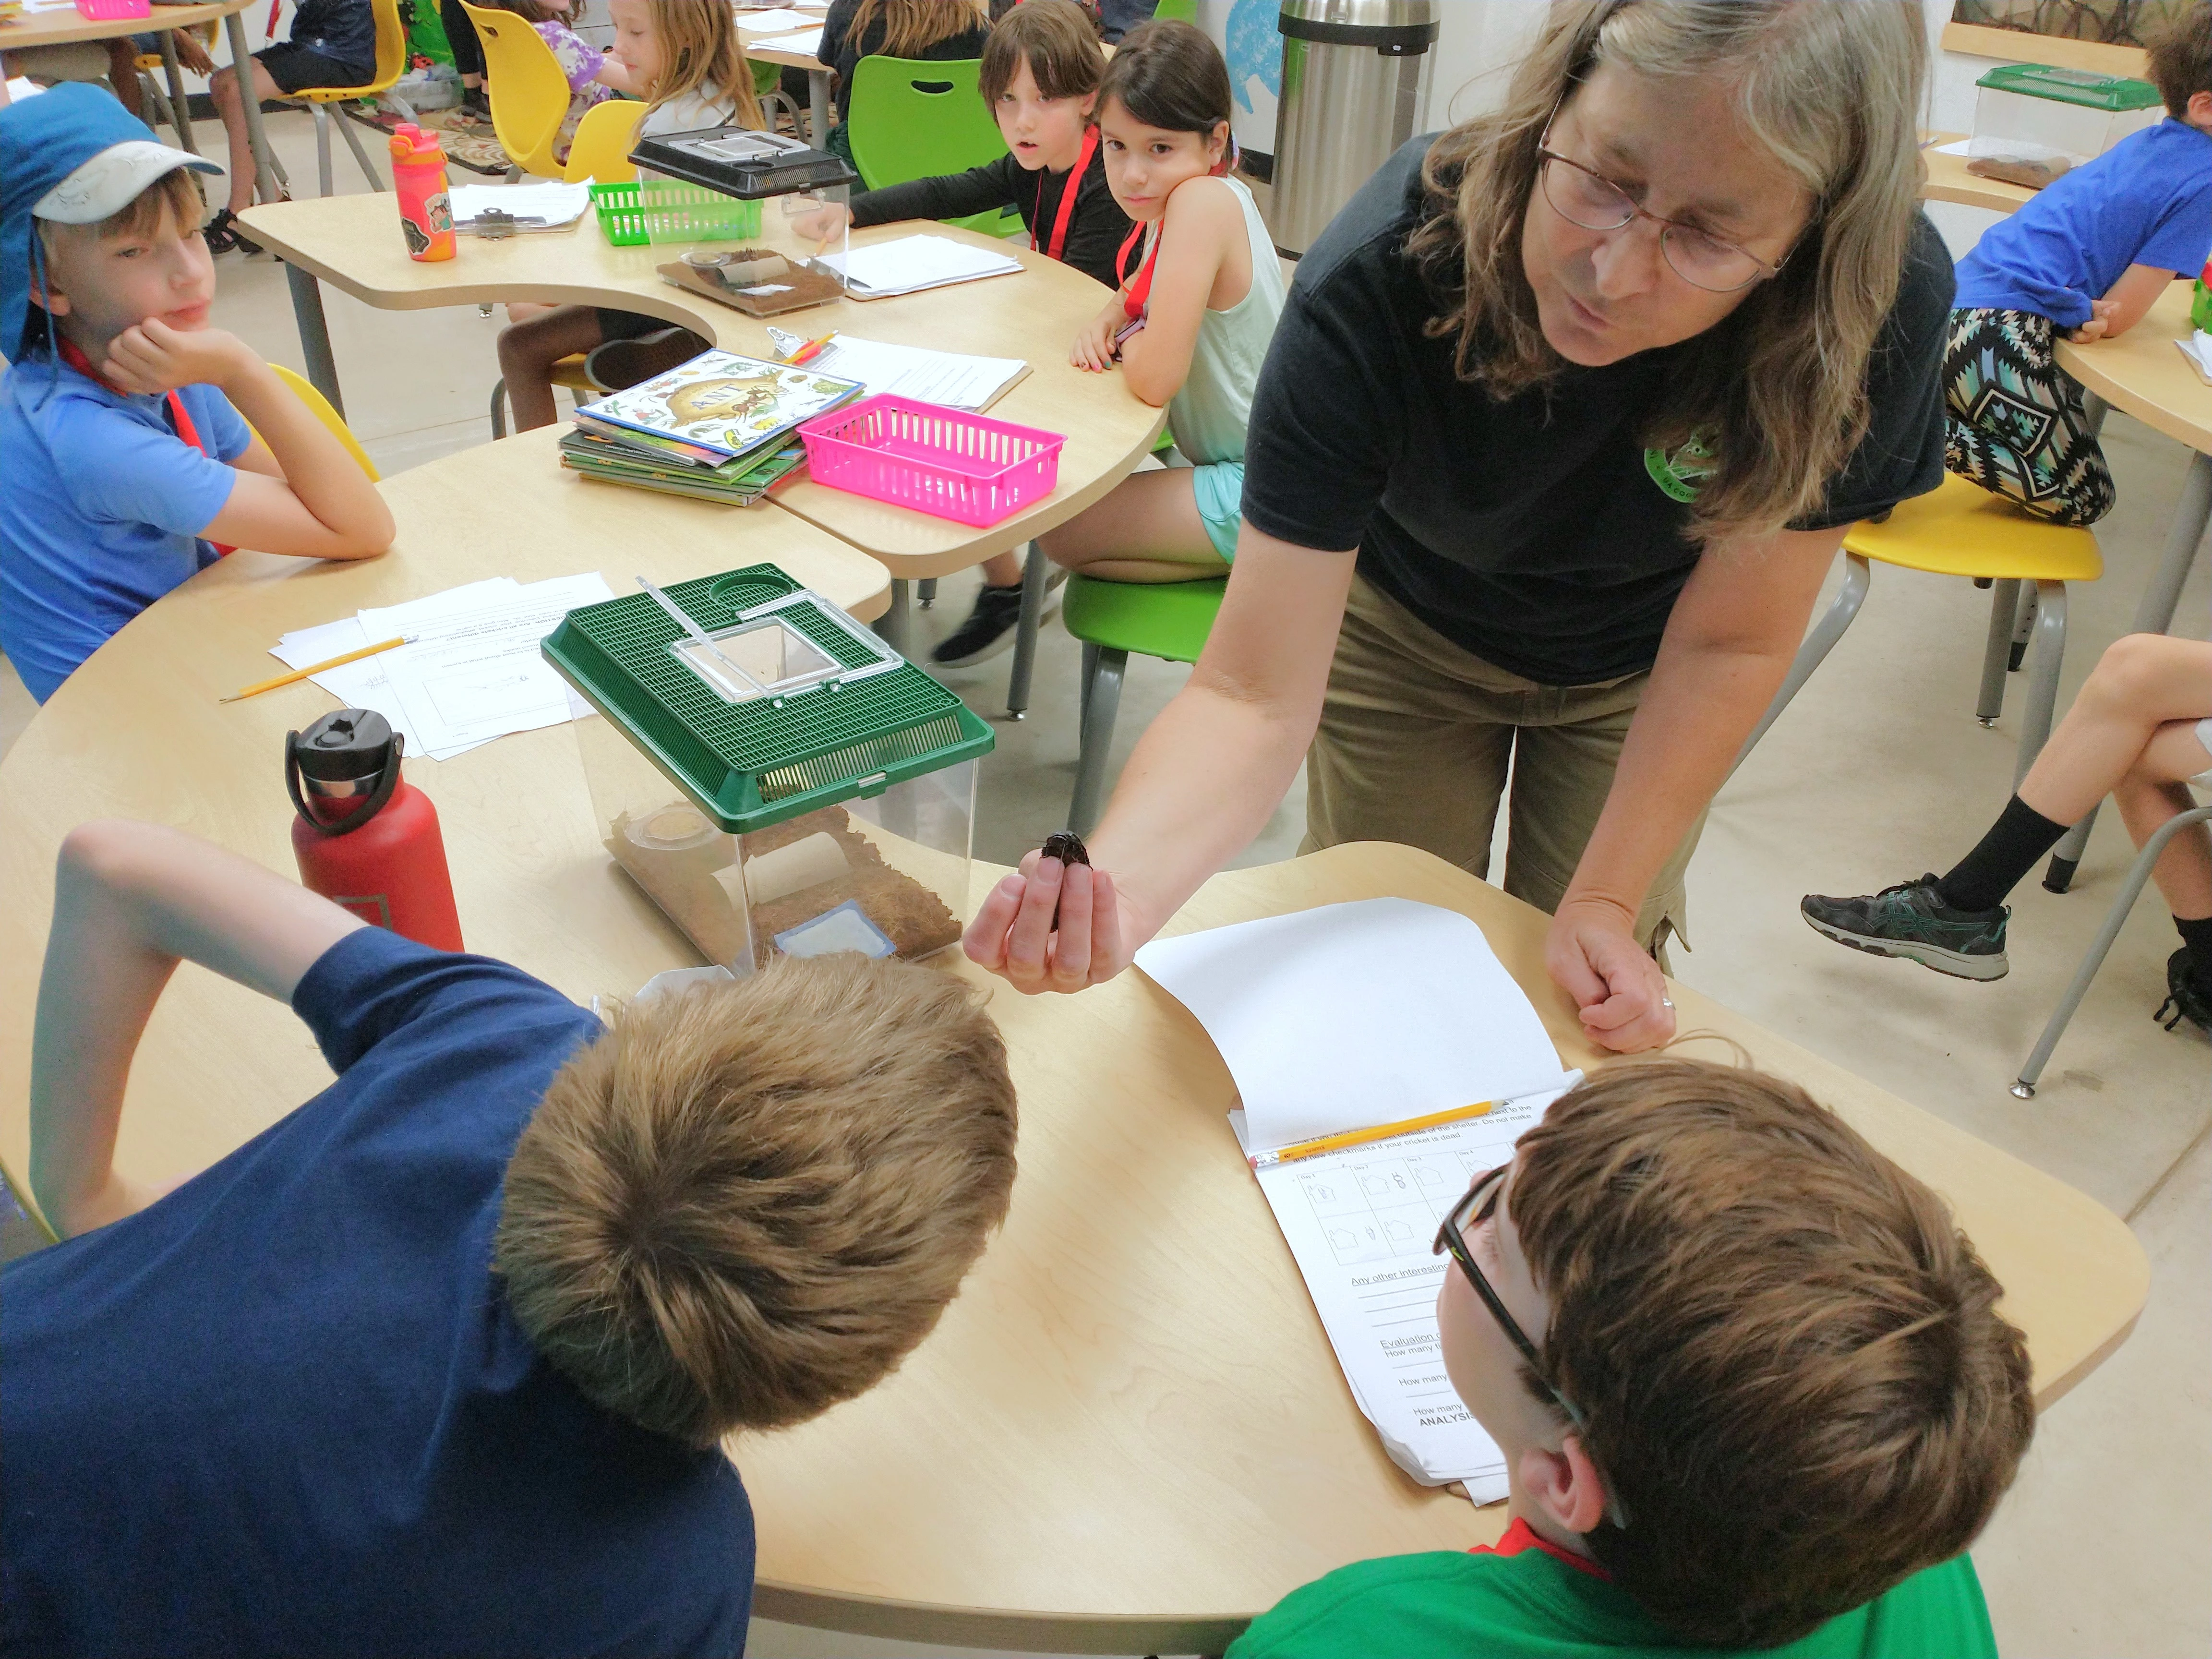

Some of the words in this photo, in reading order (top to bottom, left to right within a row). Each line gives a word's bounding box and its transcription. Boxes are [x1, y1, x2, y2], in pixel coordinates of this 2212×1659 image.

[690, 384, 743, 410] ANT
[1511, 1113, 1532, 1121] make
[1328, 1145, 1376, 1157] checkmarks
[1385, 1141, 1402, 1150] your
[1404, 1136, 1431, 1146] cricket
[1441, 1132, 1463, 1141] dead.
[1351, 1277, 1370, 1286] Any
[1372, 1272, 1398, 1283] other
[1380, 1334, 1434, 1349] Evaluation
[1384, 1349, 1406, 1358] How
[1408, 1345, 1433, 1355] many
[1398, 1378, 1419, 1386] How
[1421, 1374, 1447, 1383] many
[1412, 1407, 1434, 1416] How
[1437, 1404, 1462, 1412] many
